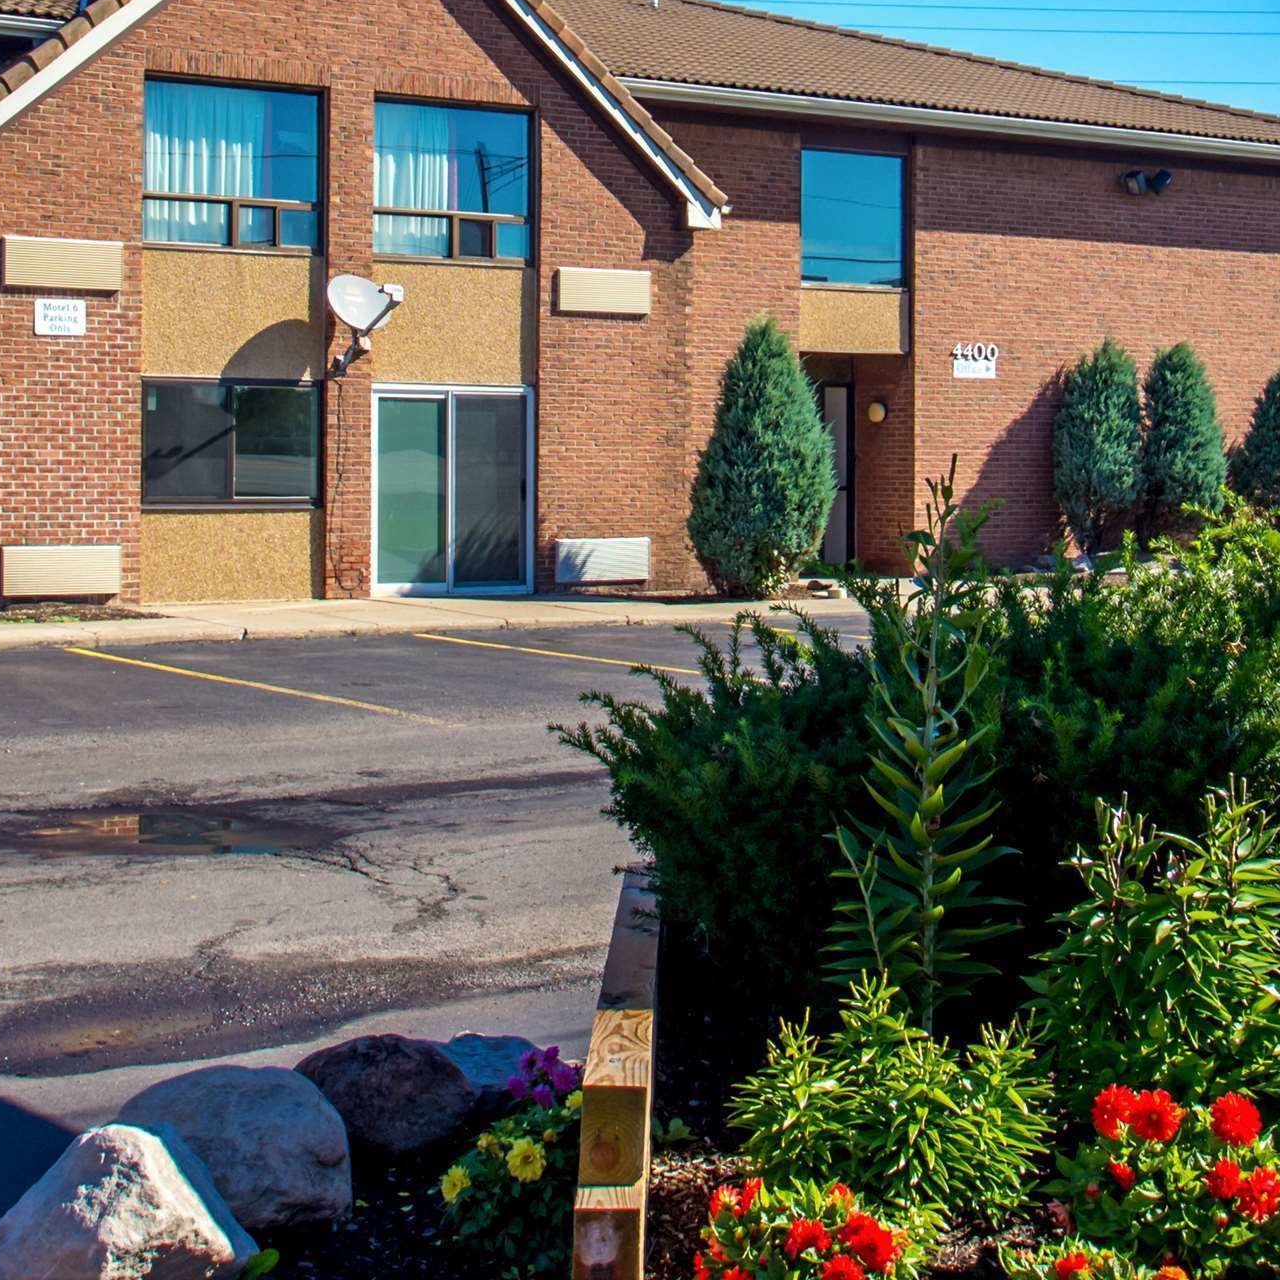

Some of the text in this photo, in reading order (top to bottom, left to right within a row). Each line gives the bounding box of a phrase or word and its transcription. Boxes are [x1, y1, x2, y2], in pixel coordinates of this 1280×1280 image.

[43, 303, 79, 312] Motel 6
[43, 313, 79, 324] Parking
[49, 324, 71, 333] Only
[952, 342, 999, 361] 4400
